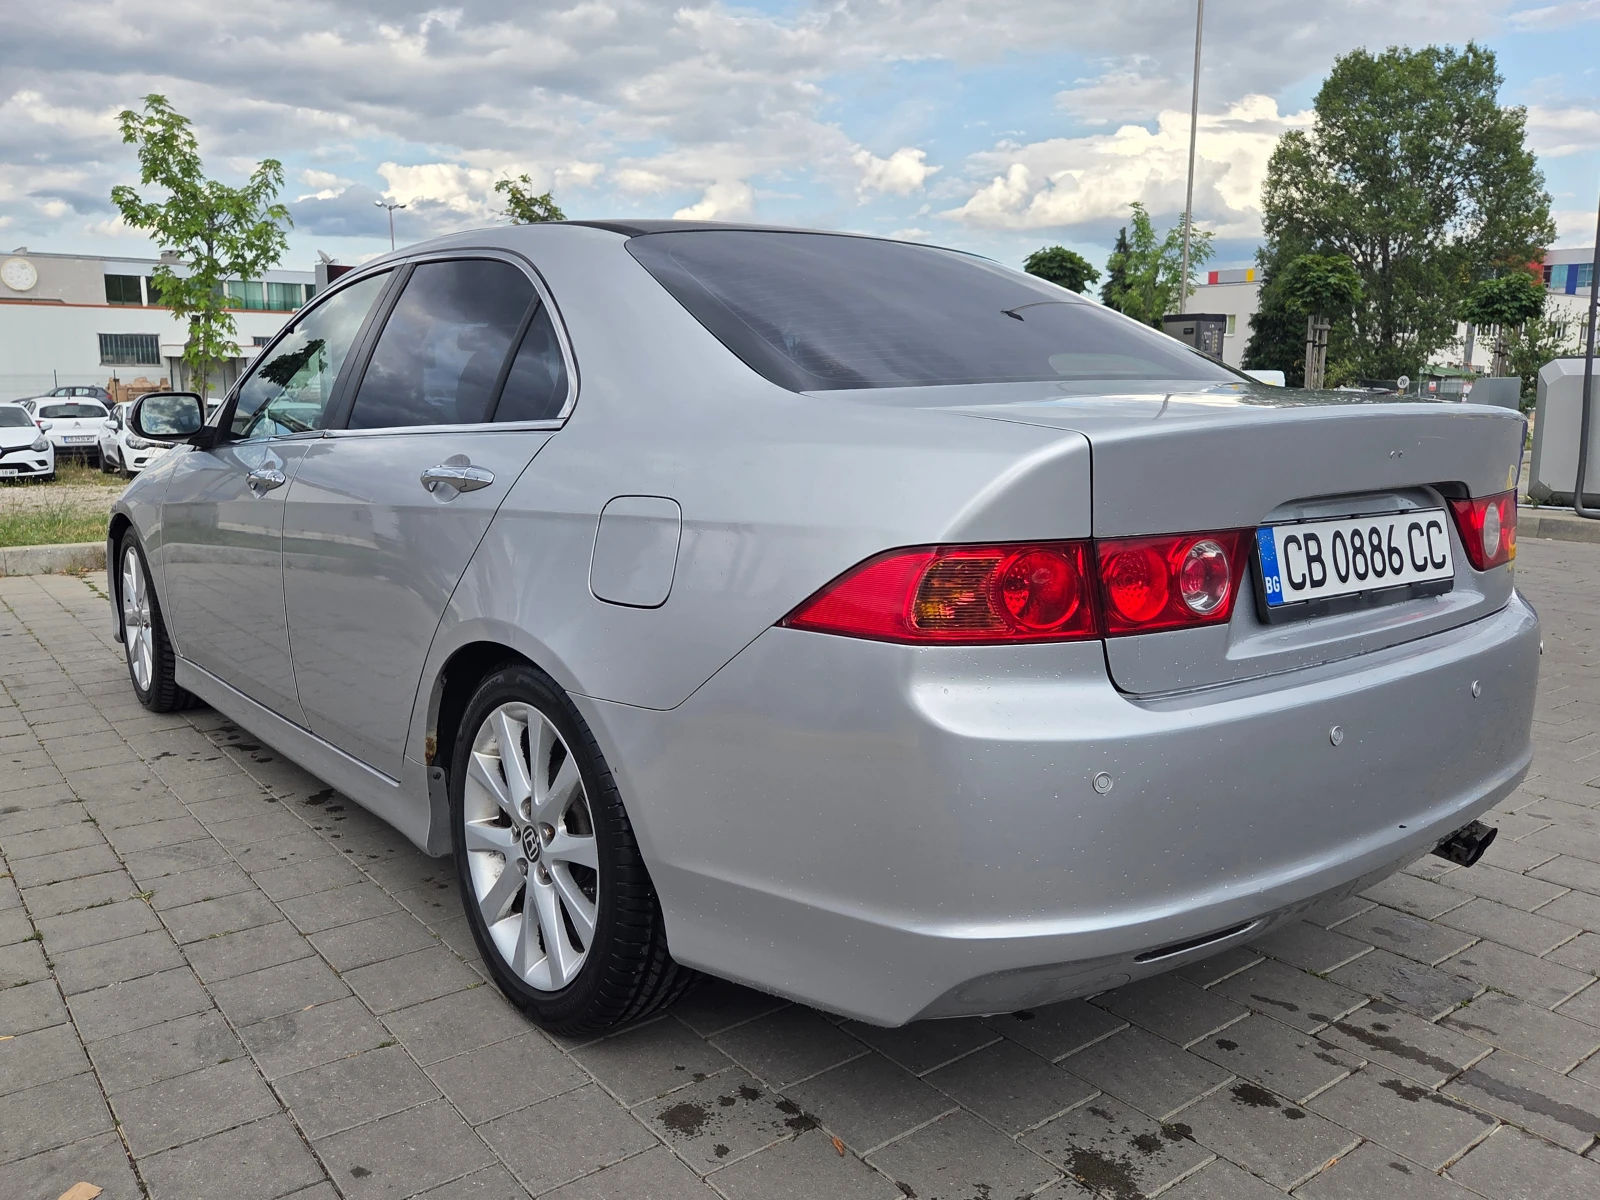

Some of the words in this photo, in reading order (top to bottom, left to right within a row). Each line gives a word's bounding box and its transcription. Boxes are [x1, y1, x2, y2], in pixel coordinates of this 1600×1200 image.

[1399, 378, 1407, 386] 20
[1283, 532, 1327, 591] CB
[1332, 524, 1404, 584] 0886
[1407, 520, 1447, 573] CC
[1265, 576, 1280, 594] BG
